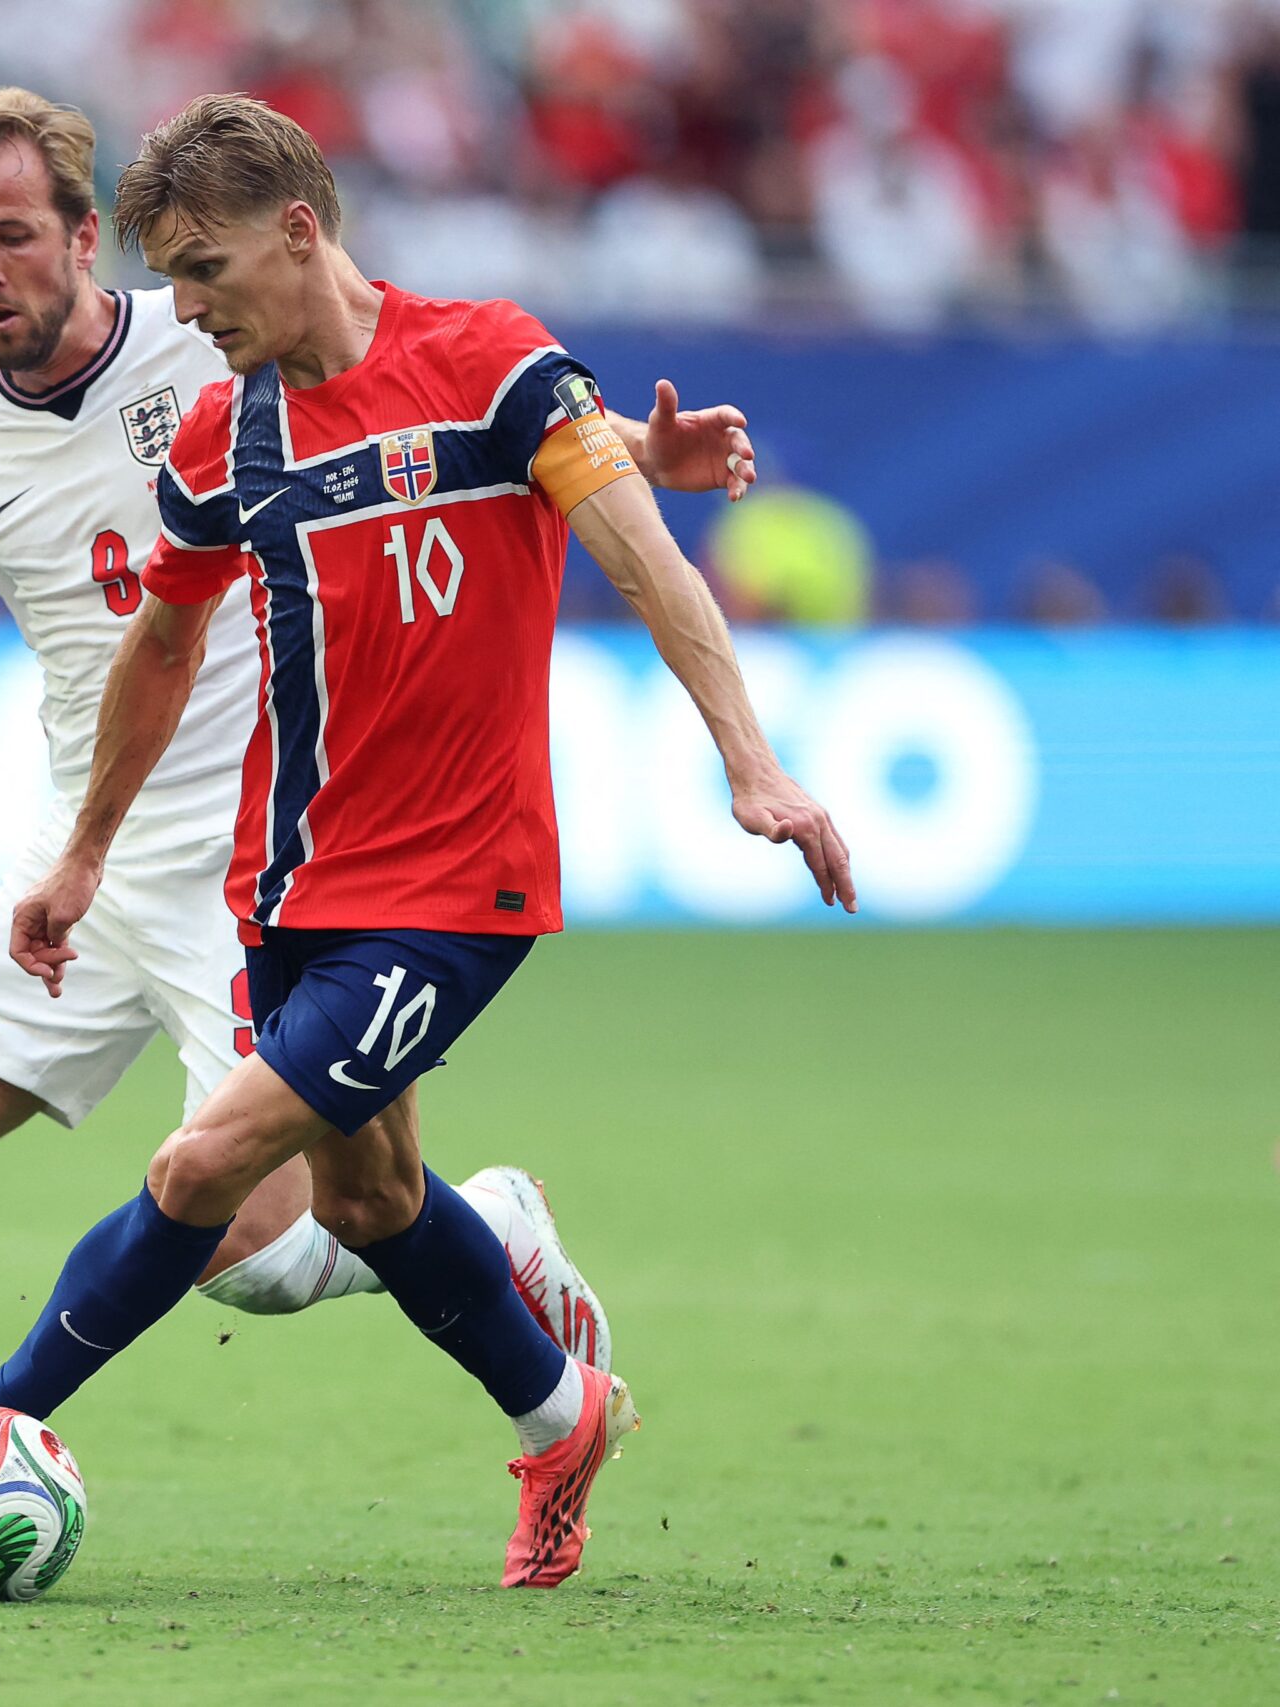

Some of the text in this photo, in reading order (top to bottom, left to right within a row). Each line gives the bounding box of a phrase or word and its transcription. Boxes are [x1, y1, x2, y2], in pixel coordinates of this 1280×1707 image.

[91, 529, 142, 616] 9
[383, 517, 464, 624] 10
[356, 965, 437, 1071] 10
